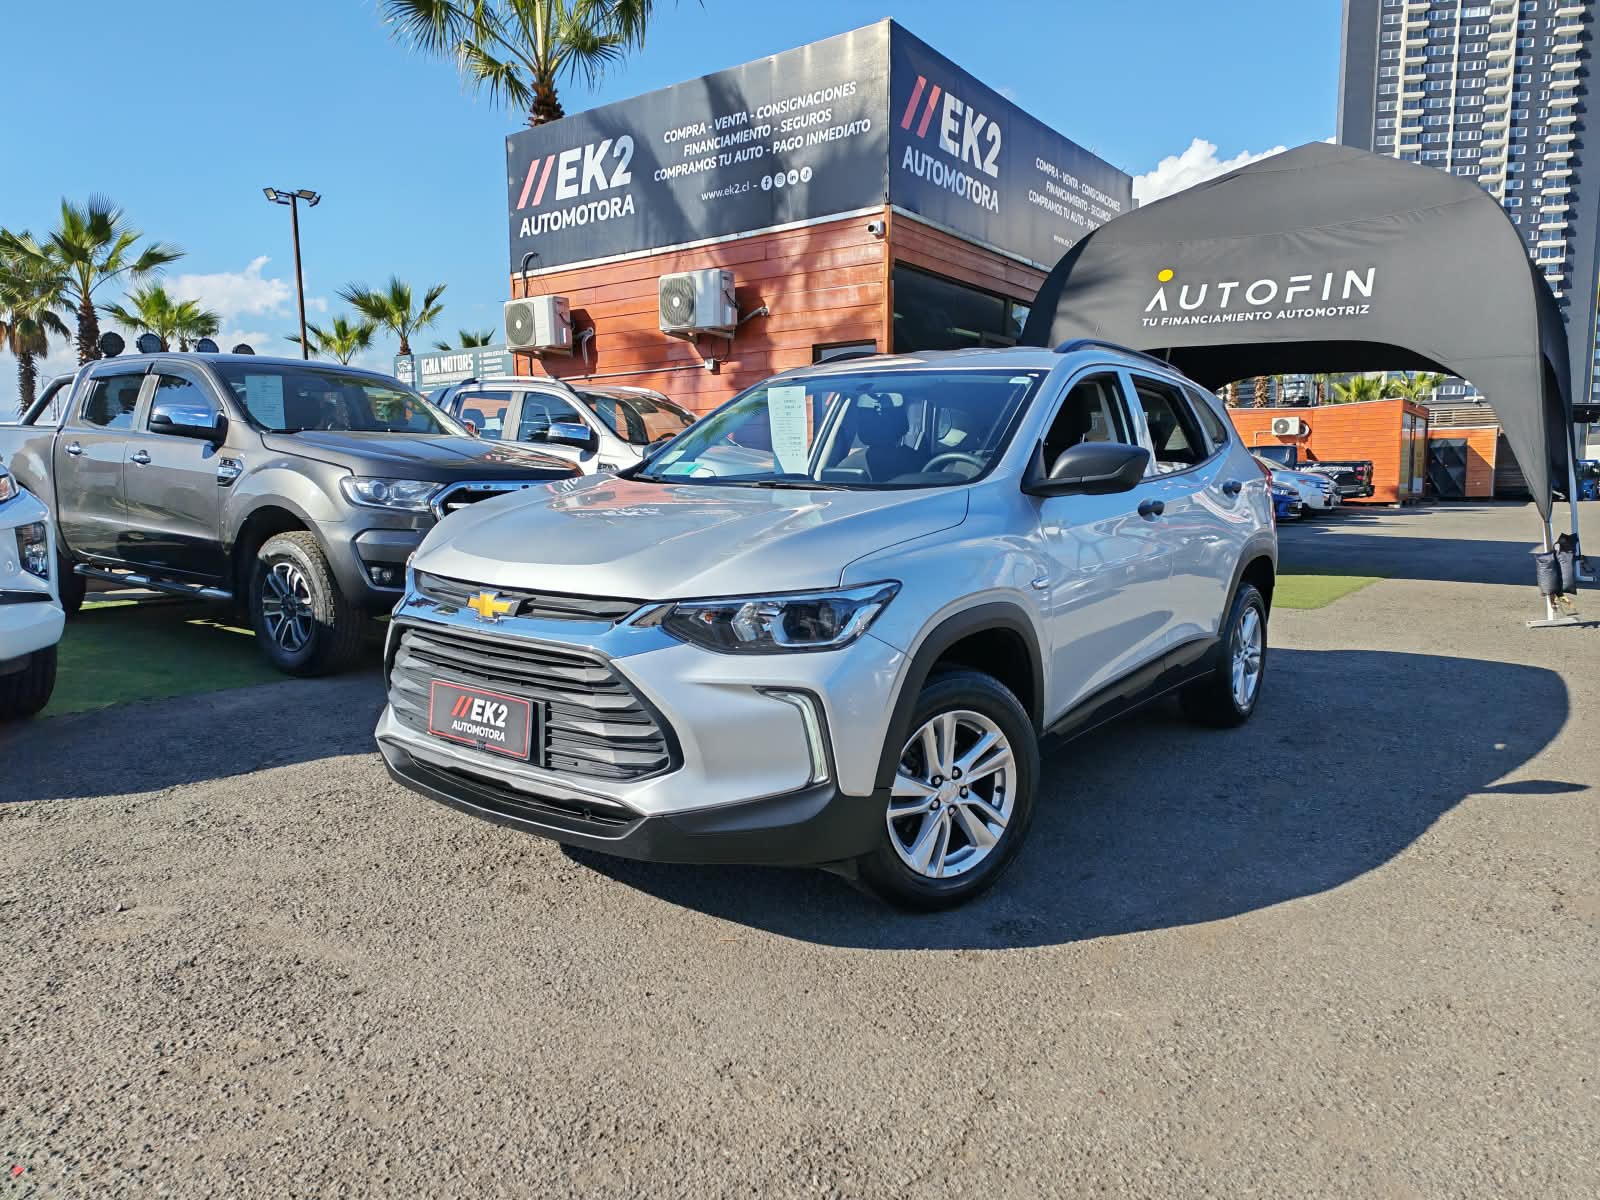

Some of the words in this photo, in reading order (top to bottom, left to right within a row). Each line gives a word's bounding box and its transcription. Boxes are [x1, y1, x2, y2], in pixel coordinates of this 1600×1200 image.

[664, 124, 706, 144] COMPRA
[715, 111, 748, 131] VENTA
[756, 81, 857, 119] CONSIGNACIONES
[654, 156, 717, 182] COMPRAMOS
[718, 152, 732, 167] TU
[733, 145, 764, 164] AUTO
[772, 135, 803, 154] PAGO
[806, 118, 871, 147] INMEDIATO
[683, 124, 771, 157] FINANCIAMIENTO
[780, 108, 832, 133] SEGUROS
[701, 181, 750, 201] www.ek2.cl
[902, 145, 999, 214] AUTOMOTORA
[1036, 157, 1059, 180] COMPRA
[1062, 172, 1079, 190] VENTA
[1029, 189, 1063, 216] COMPRAMOS
[1063, 207, 1070, 219] TU
[1070, 211, 1084, 226] AUTO
[1046, 181, 1088, 212] FINANCIAMIENTO
[519, 194, 635, 238] AUTOMOTORA
[1144, 267, 1376, 312] AUTOFIN
[1142, 317, 1158, 327] TU
[1161, 310, 1273, 327] FINANCIAMIENTO
[1276, 304, 1371, 320] AUTOMOTRIZ
[440, 353, 474, 374] MOTORS
[451, 720, 505, 742] AUTOMOTORA
